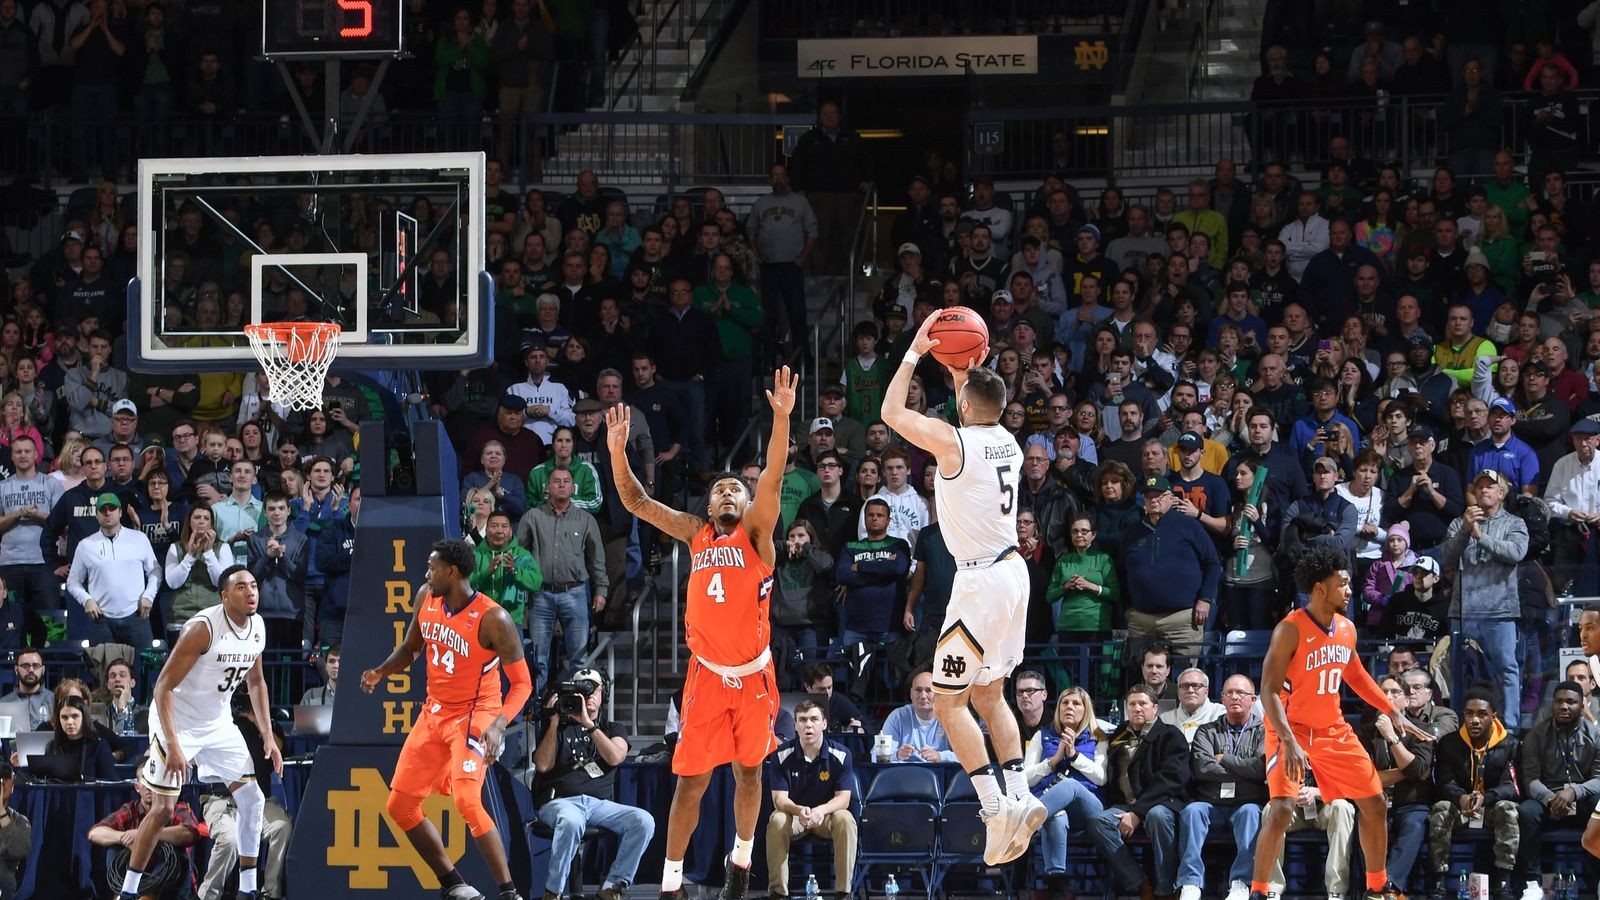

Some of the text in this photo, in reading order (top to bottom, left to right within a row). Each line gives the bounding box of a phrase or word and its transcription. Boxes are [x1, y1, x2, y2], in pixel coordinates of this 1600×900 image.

[338, 0, 374, 37] 5
[807, 52, 1026, 70] ACC FLORIDA STATE
[979, 132, 1000, 144] 115
[936, 314, 966, 324] NCAA
[526, 396, 553, 404] RISH
[864, 395, 873, 413] 3
[5, 490, 46, 501] NOTRE DAME
[996, 465, 1014, 515] 5
[692, 546, 746, 573] CLEMSON
[854, 551, 875, 563] NOTRE
[706, 572, 725, 603] 4
[1396, 612, 1440, 631] POLICE
[420, 621, 470, 659] CLEMSON
[216, 653, 241, 663] NOTRE
[431, 643, 456, 675] 14
[217, 666, 249, 692] 35
[1316, 668, 1342, 695] 10
